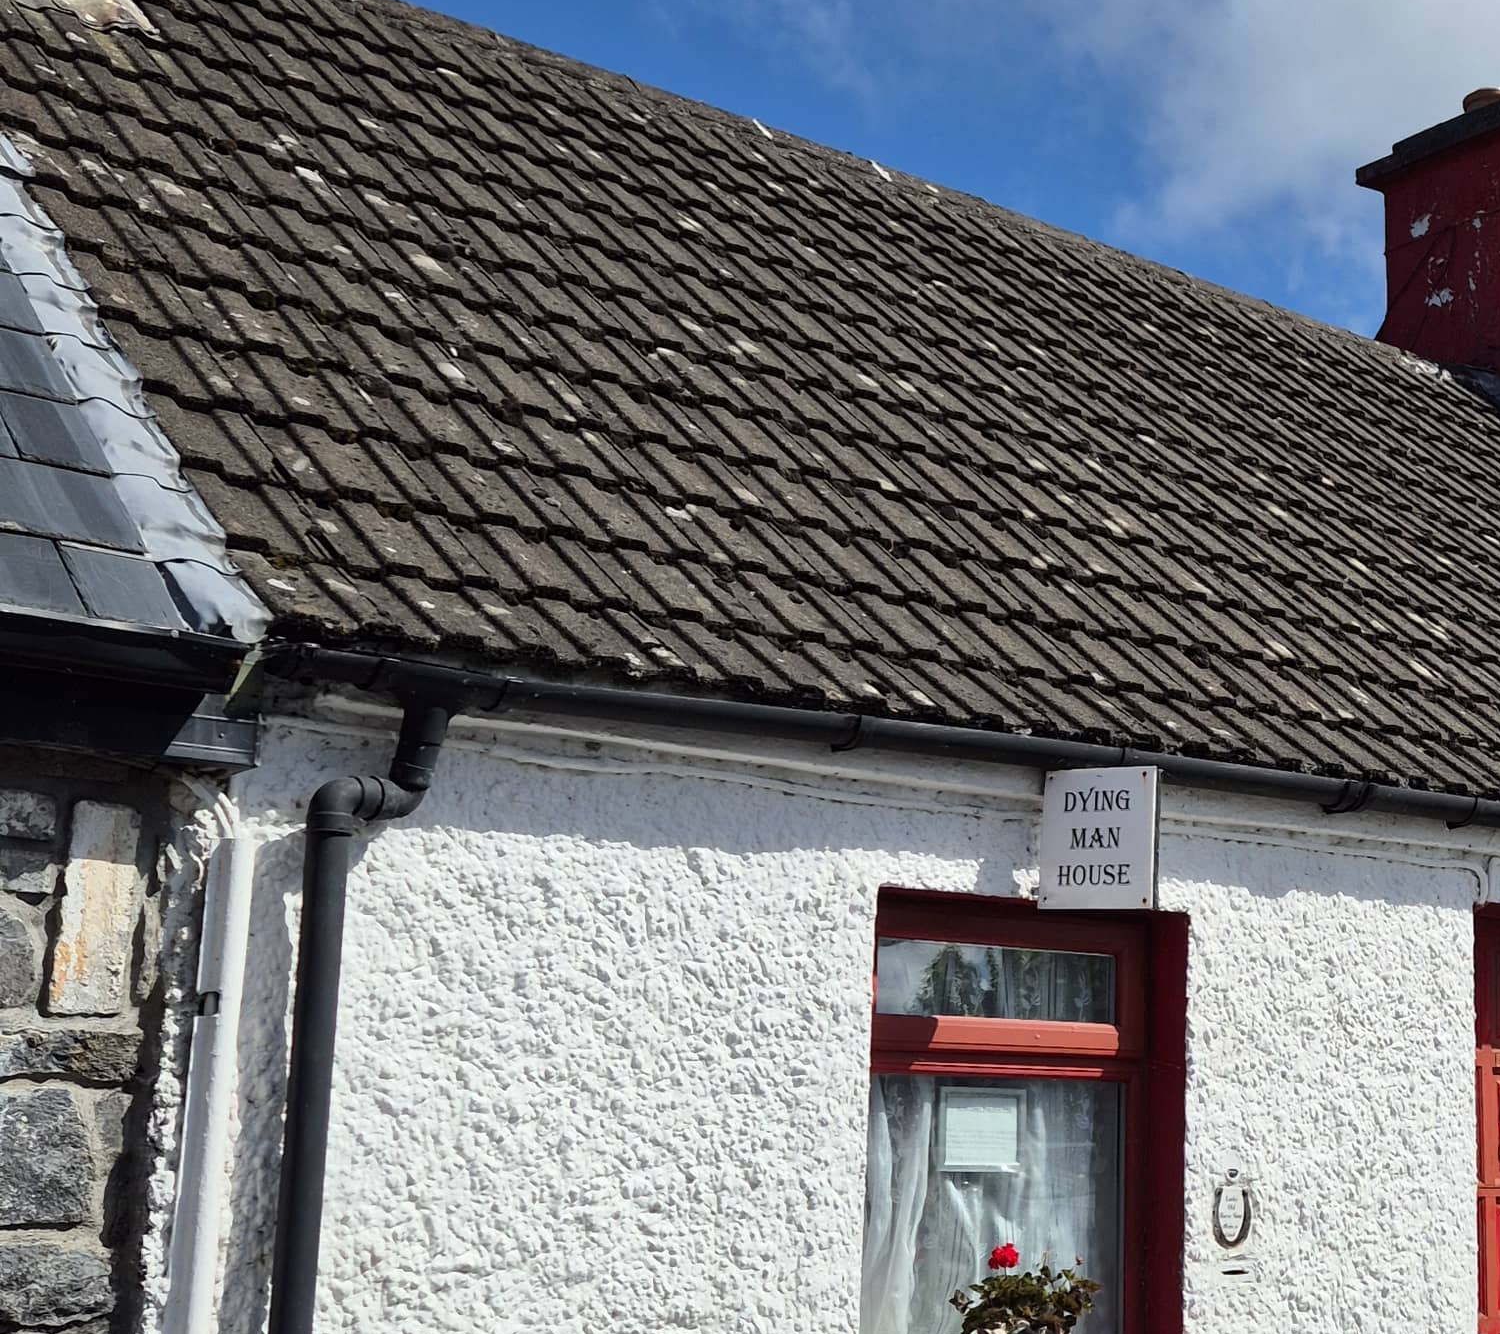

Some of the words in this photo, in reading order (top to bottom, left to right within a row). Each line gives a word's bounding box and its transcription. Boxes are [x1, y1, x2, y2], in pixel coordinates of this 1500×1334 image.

[1064, 786, 1131, 813] DYING
[1070, 826, 1122, 850] MAN
[1057, 863, 1131, 887] HOUSE
